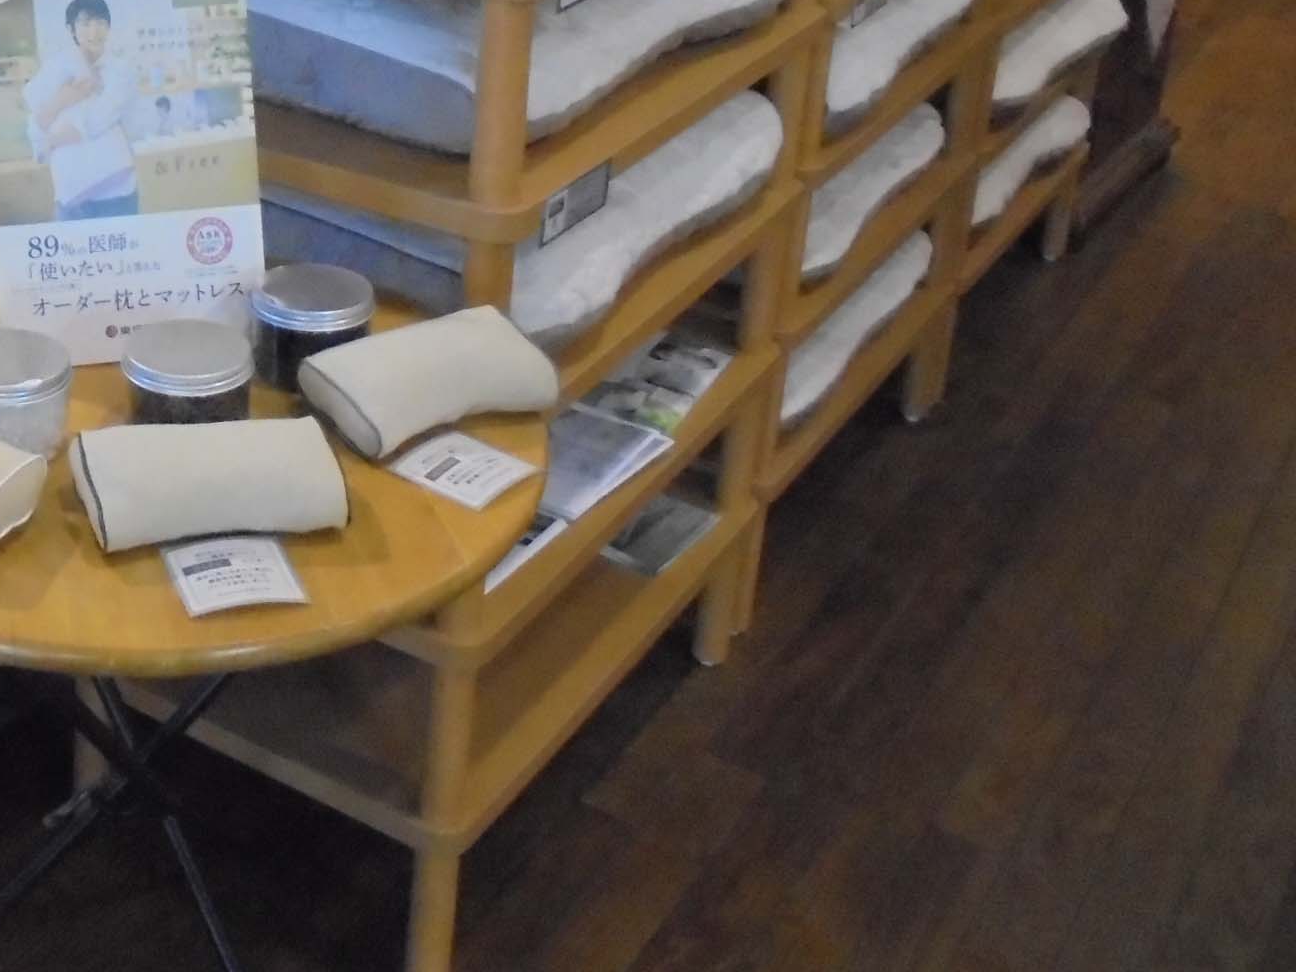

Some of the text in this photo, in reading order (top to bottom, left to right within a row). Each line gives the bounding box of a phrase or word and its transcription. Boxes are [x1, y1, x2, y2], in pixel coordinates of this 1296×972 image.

[31, 280, 246, 318] オーダー枕とマットレス
